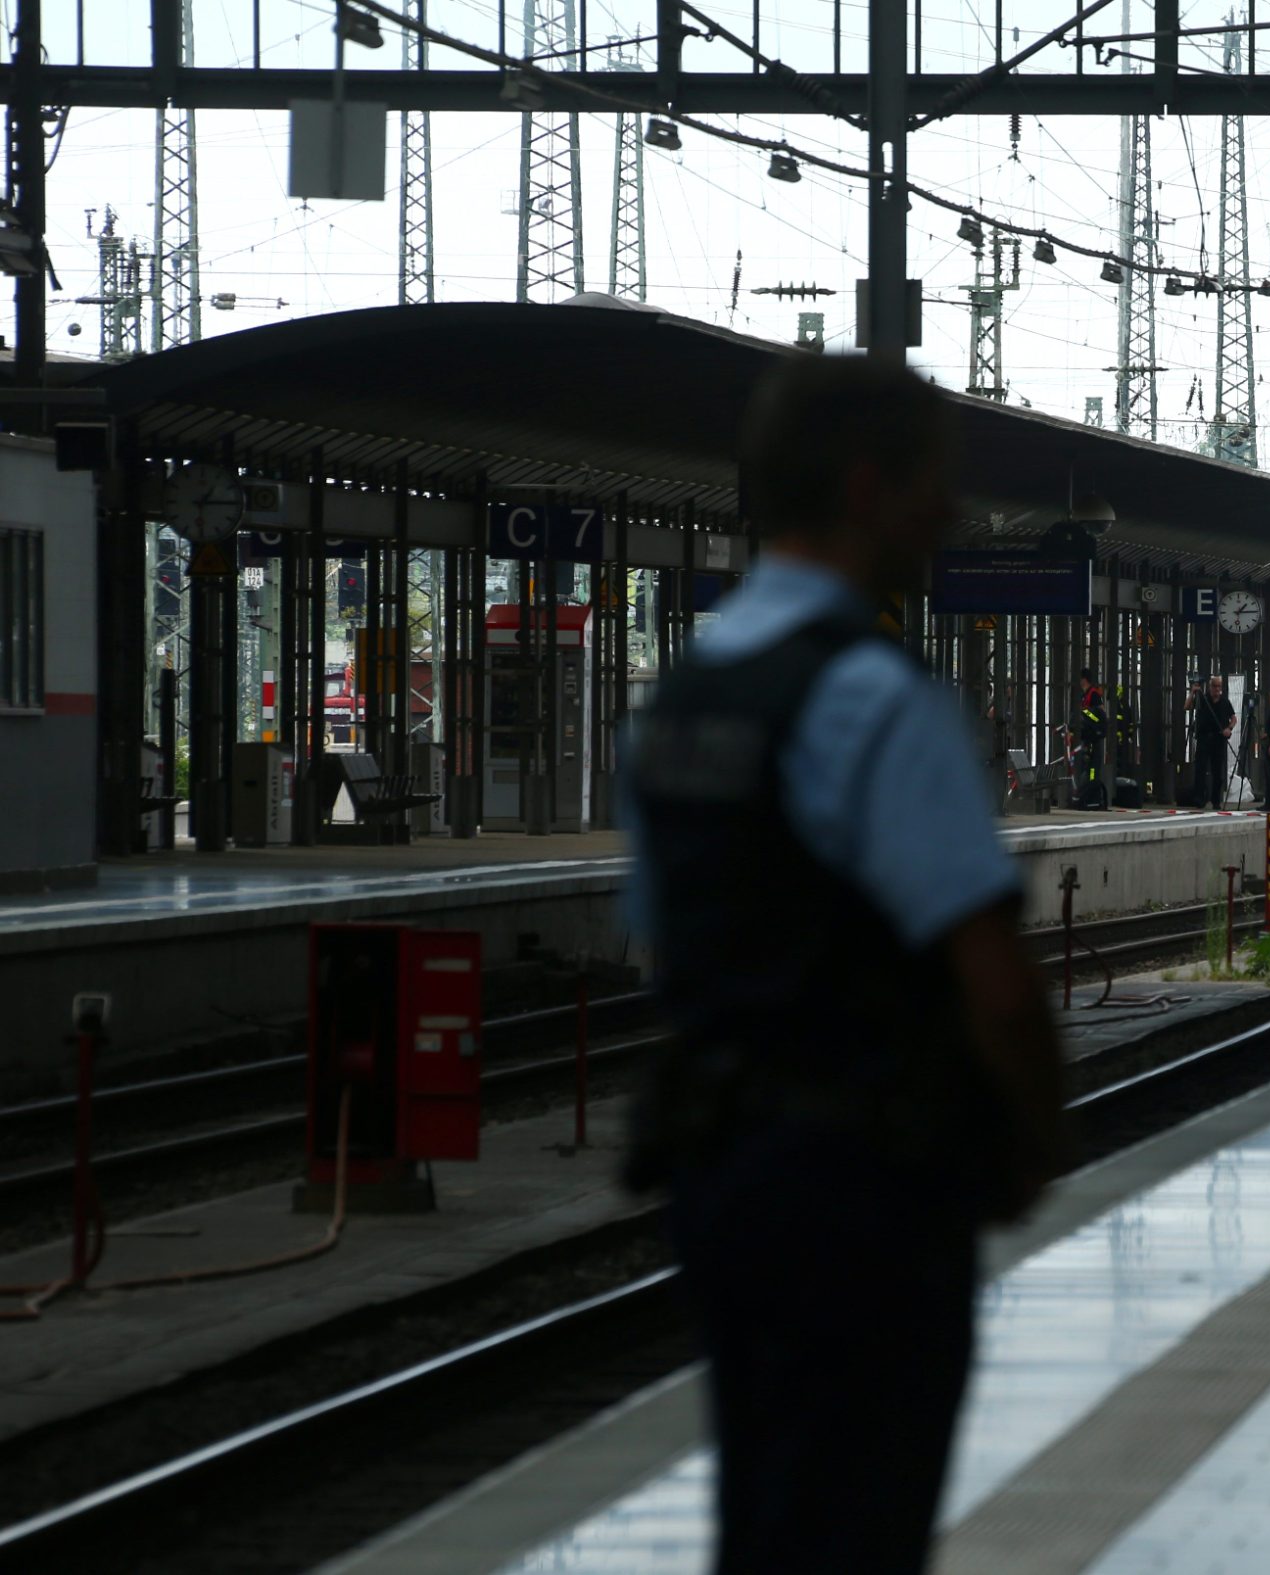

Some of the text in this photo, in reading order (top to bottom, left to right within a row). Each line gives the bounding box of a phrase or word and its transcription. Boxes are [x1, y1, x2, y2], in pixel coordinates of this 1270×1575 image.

[507, 507, 596, 548] C 7
[1197, 589, 1214, 615] E
